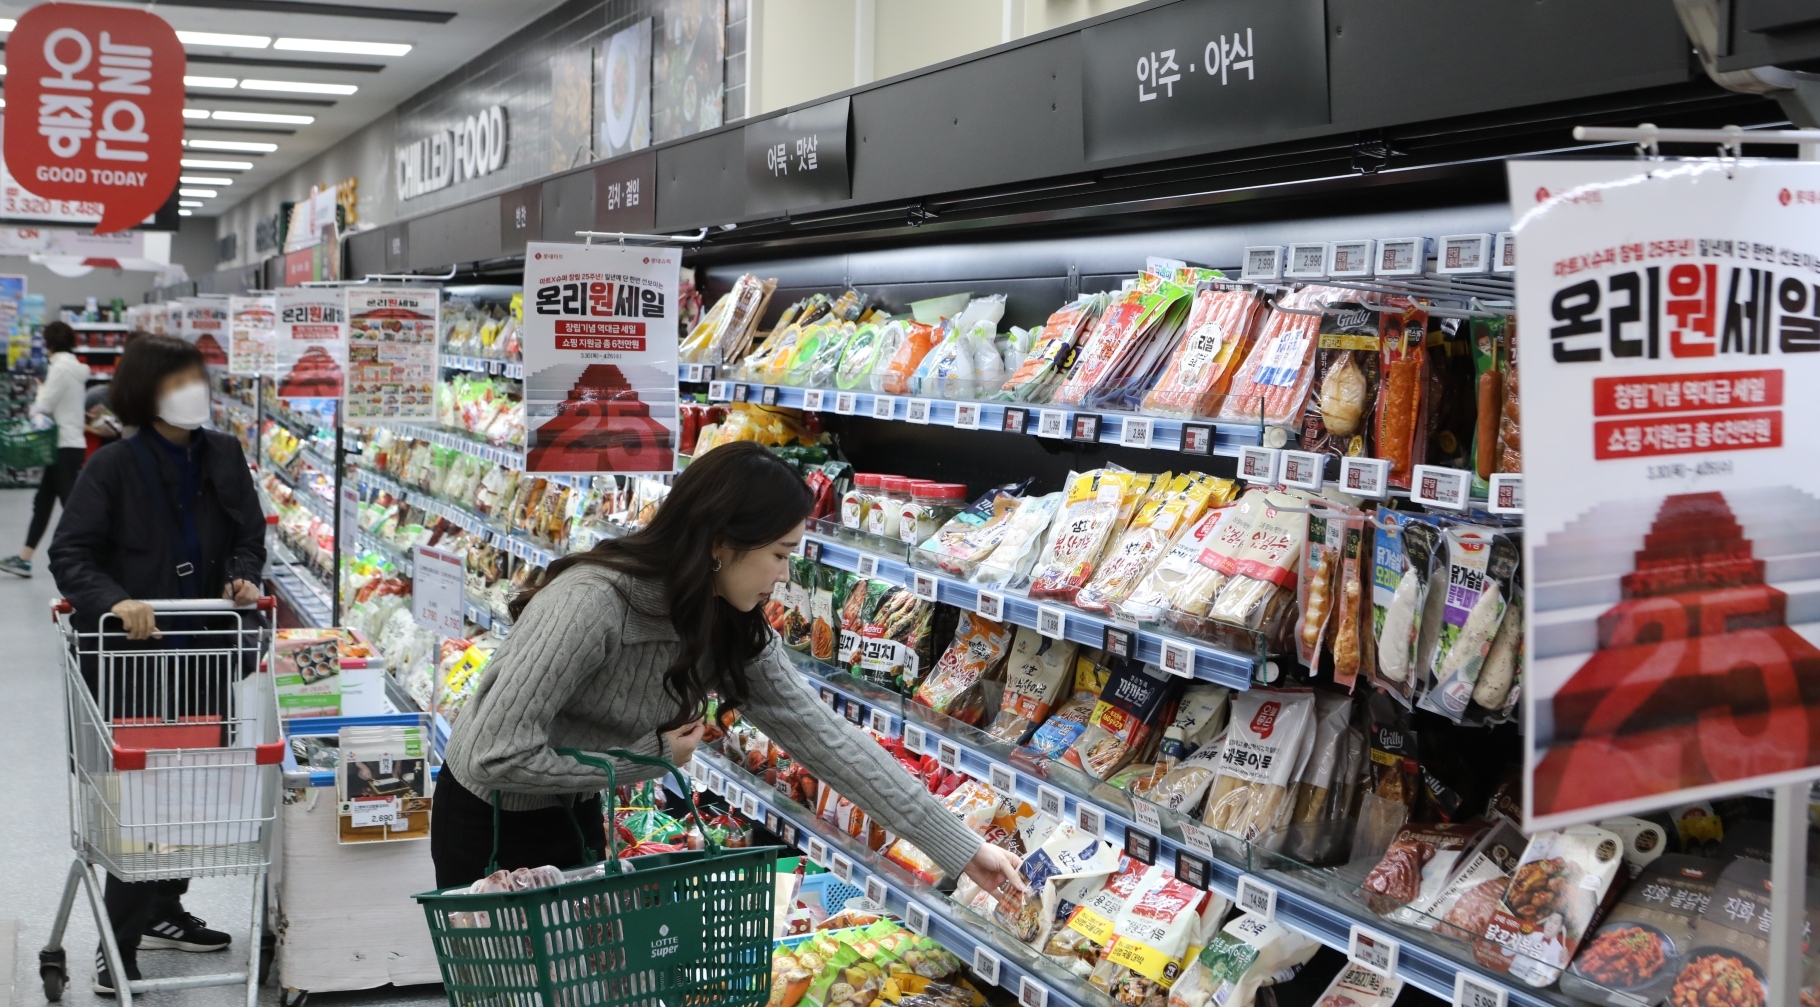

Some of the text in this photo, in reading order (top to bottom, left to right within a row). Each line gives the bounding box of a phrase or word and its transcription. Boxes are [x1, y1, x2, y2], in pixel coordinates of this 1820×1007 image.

[1136, 28, 1254, 102] 안주 야식
[398, 104, 508, 200] CHILLED FOOD
[767, 134, 818, 177] 어묵 맛살
[36, 165, 148, 187] GOOD TODAY
[608, 177, 640, 210] 김치 절임
[1257, 258, 1275, 271] 2,990
[1303, 255, 1322, 268] 2,990
[539, 273, 664, 290] 마트X슈퍼 창립 25주년! 일년에 단 한번 선보이는
[535, 282, 665, 318] 온리원세일
[1549, 263, 1820, 363] 온리원세일
[565, 323, 636, 334] 창립기념 역대급 세일
[562, 338, 639, 349] 쇼핑 지원금 총 6천만원
[1732, 377, 1766, 402] 세일
[535, 400, 660, 472] 25
[1607, 426, 1642, 452] 쇼핑
[1376, 545, 1402, 574] 닭가슴살
[1451, 564, 1485, 592] 닭가슴살
[1379, 728, 1404, 749] Grilly
[651, 936, 679, 948] LOTTE
[651, 944, 679, 958] super
